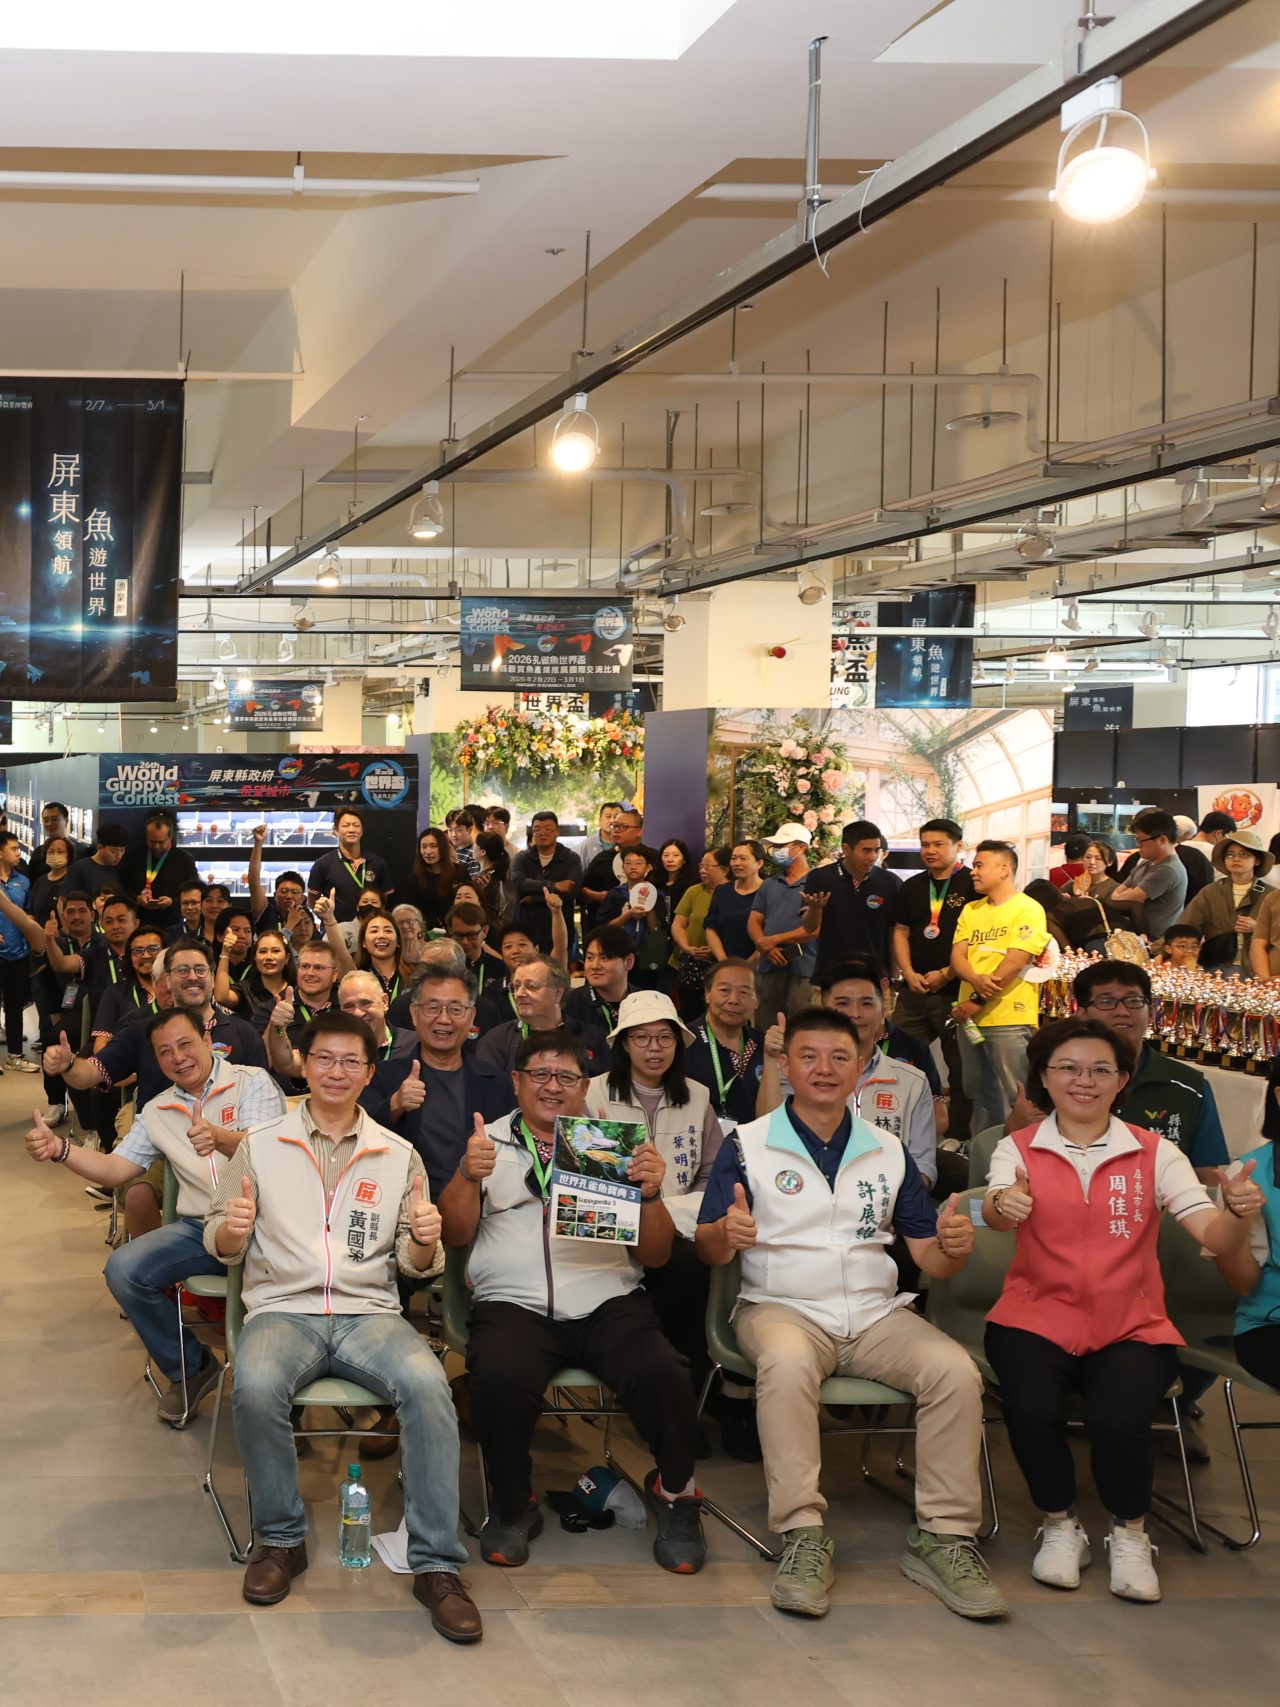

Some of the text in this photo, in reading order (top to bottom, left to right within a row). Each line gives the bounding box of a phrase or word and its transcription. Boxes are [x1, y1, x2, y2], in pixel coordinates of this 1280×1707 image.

[85, 400, 165, 411] 2/7 3/1
[47, 452, 82, 576] 屏東領航
[83, 507, 115, 617] 魚遊世界
[465, 615, 501, 626] Guppy
[472, 607, 509, 619] World
[469, 622, 510, 633] Contest
[508, 654, 587, 665] 2026孔雀魚世界盃
[526, 694, 585, 713] 世界盃
[139, 761, 160, 769] 26th
[117, 765, 178, 781] World
[208, 769, 275, 783] 屏東縣政府
[106, 778, 166, 797] Guppy
[112, 790, 181, 806] Contest
[1108, 1174, 1131, 1240] 周佳琪
